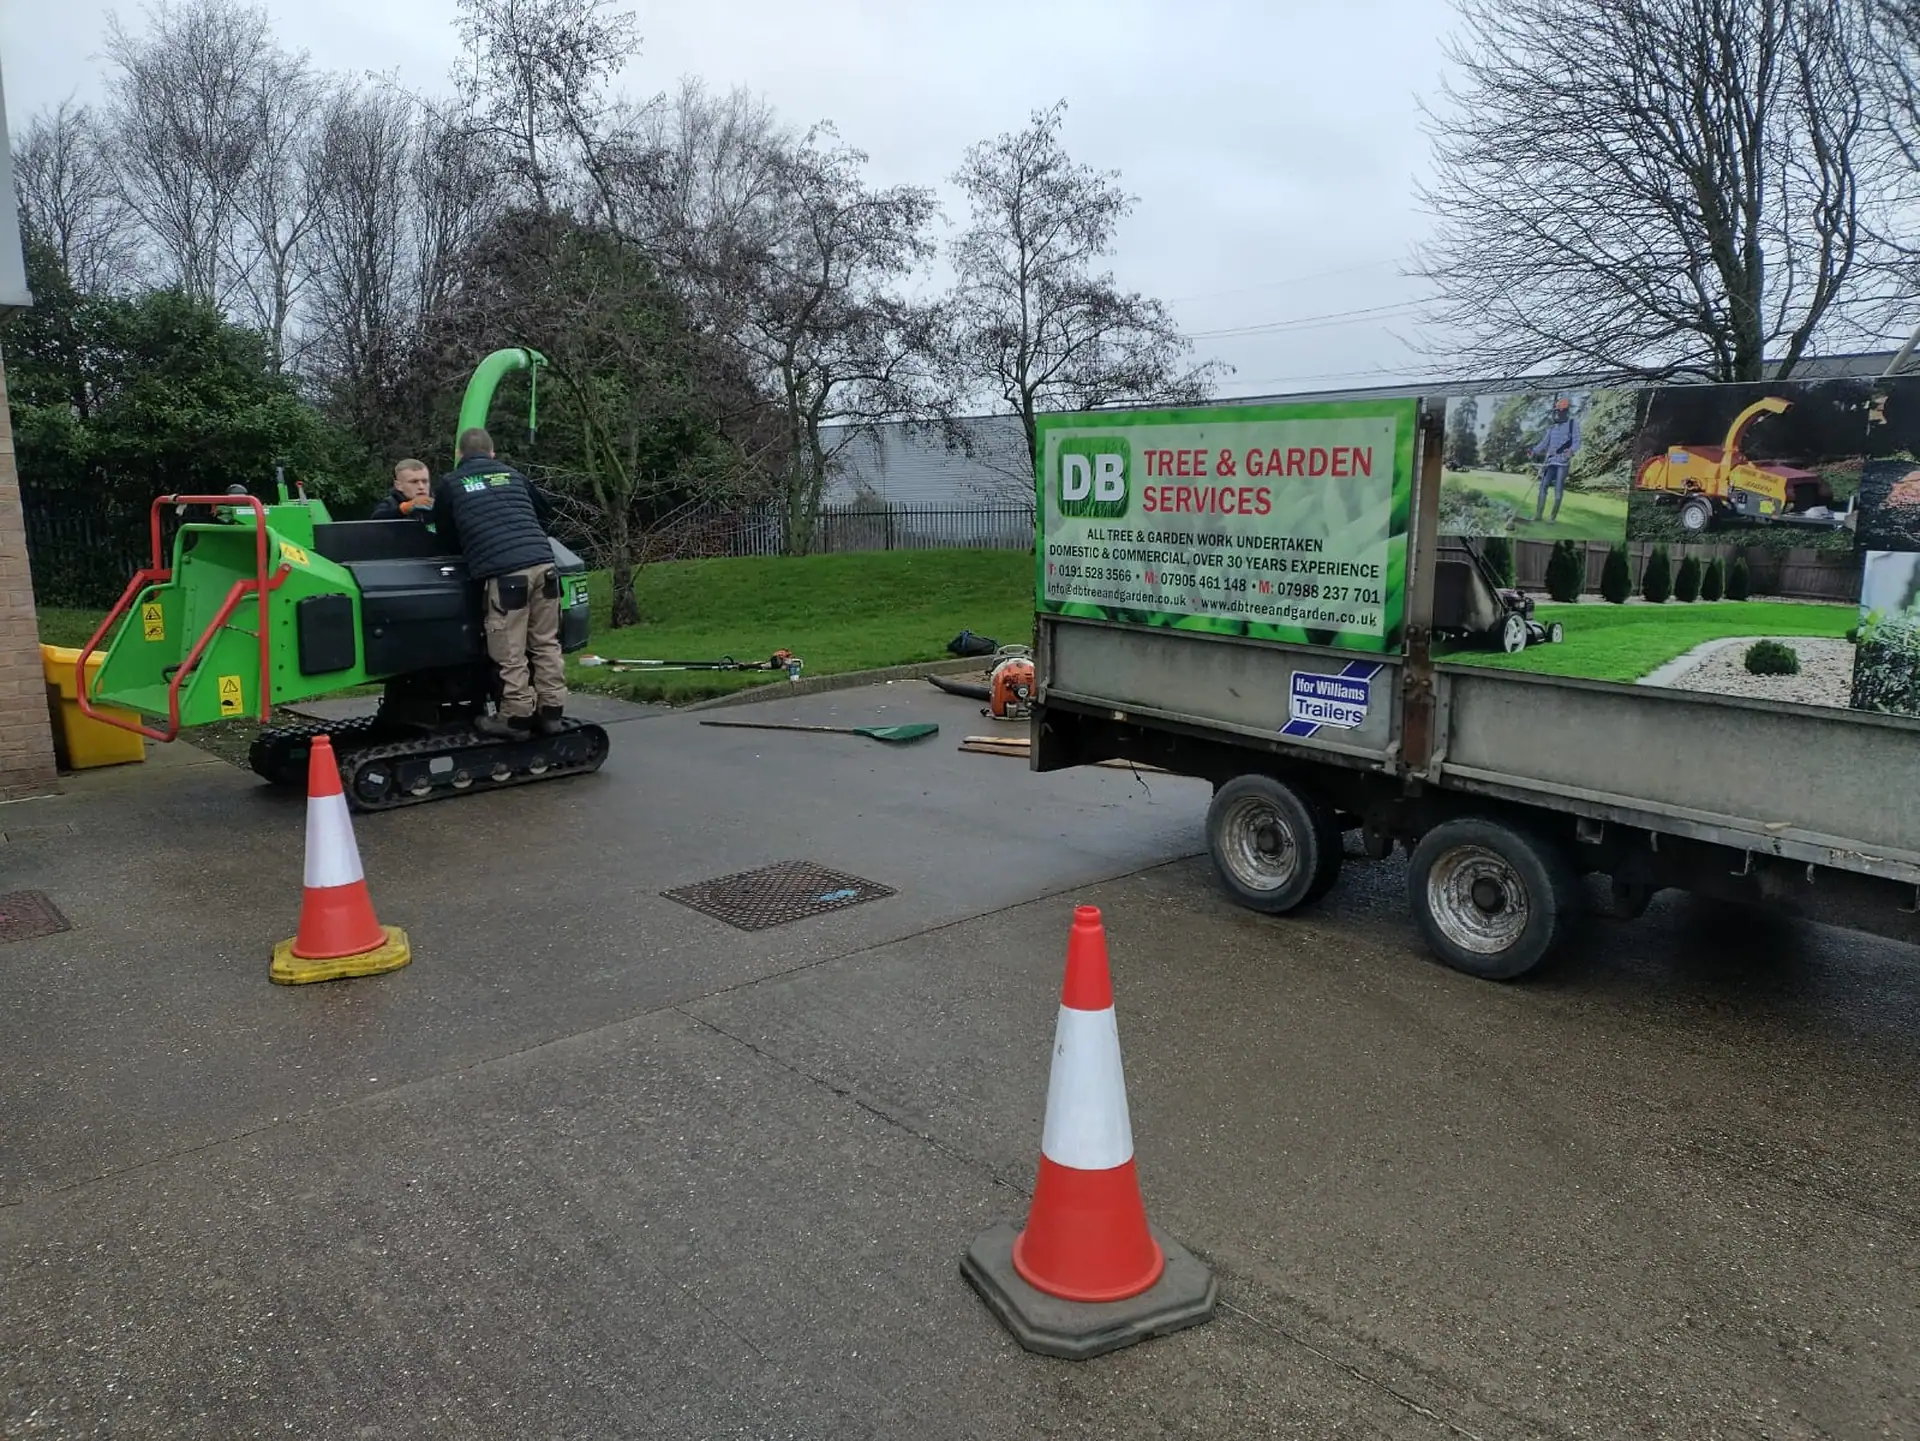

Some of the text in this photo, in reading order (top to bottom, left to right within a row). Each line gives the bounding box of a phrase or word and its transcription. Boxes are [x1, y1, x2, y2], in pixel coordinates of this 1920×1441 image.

[1143, 447, 1373, 477] TREE & GARDEN
[1062, 453, 1126, 502] DB
[1142, 485, 1272, 515] SERVICES
[1087, 528, 1323, 553] ALL TREE & GARDEN WORK UNDERTAKEN
[1049, 544, 1380, 578] DOMESTIC & COMMERCIAL, OVER 30 YEARS EXPERIENCE
[1049, 562, 1380, 604] T: 0191 528 3566 M: 07905 461 148 M: 07988 237 701
[1201, 598, 1377, 627] www.dbtreeandgarden.co.uk
[1316, 680, 1365, 700] Williams
[1296, 698, 1364, 723] Trailers
